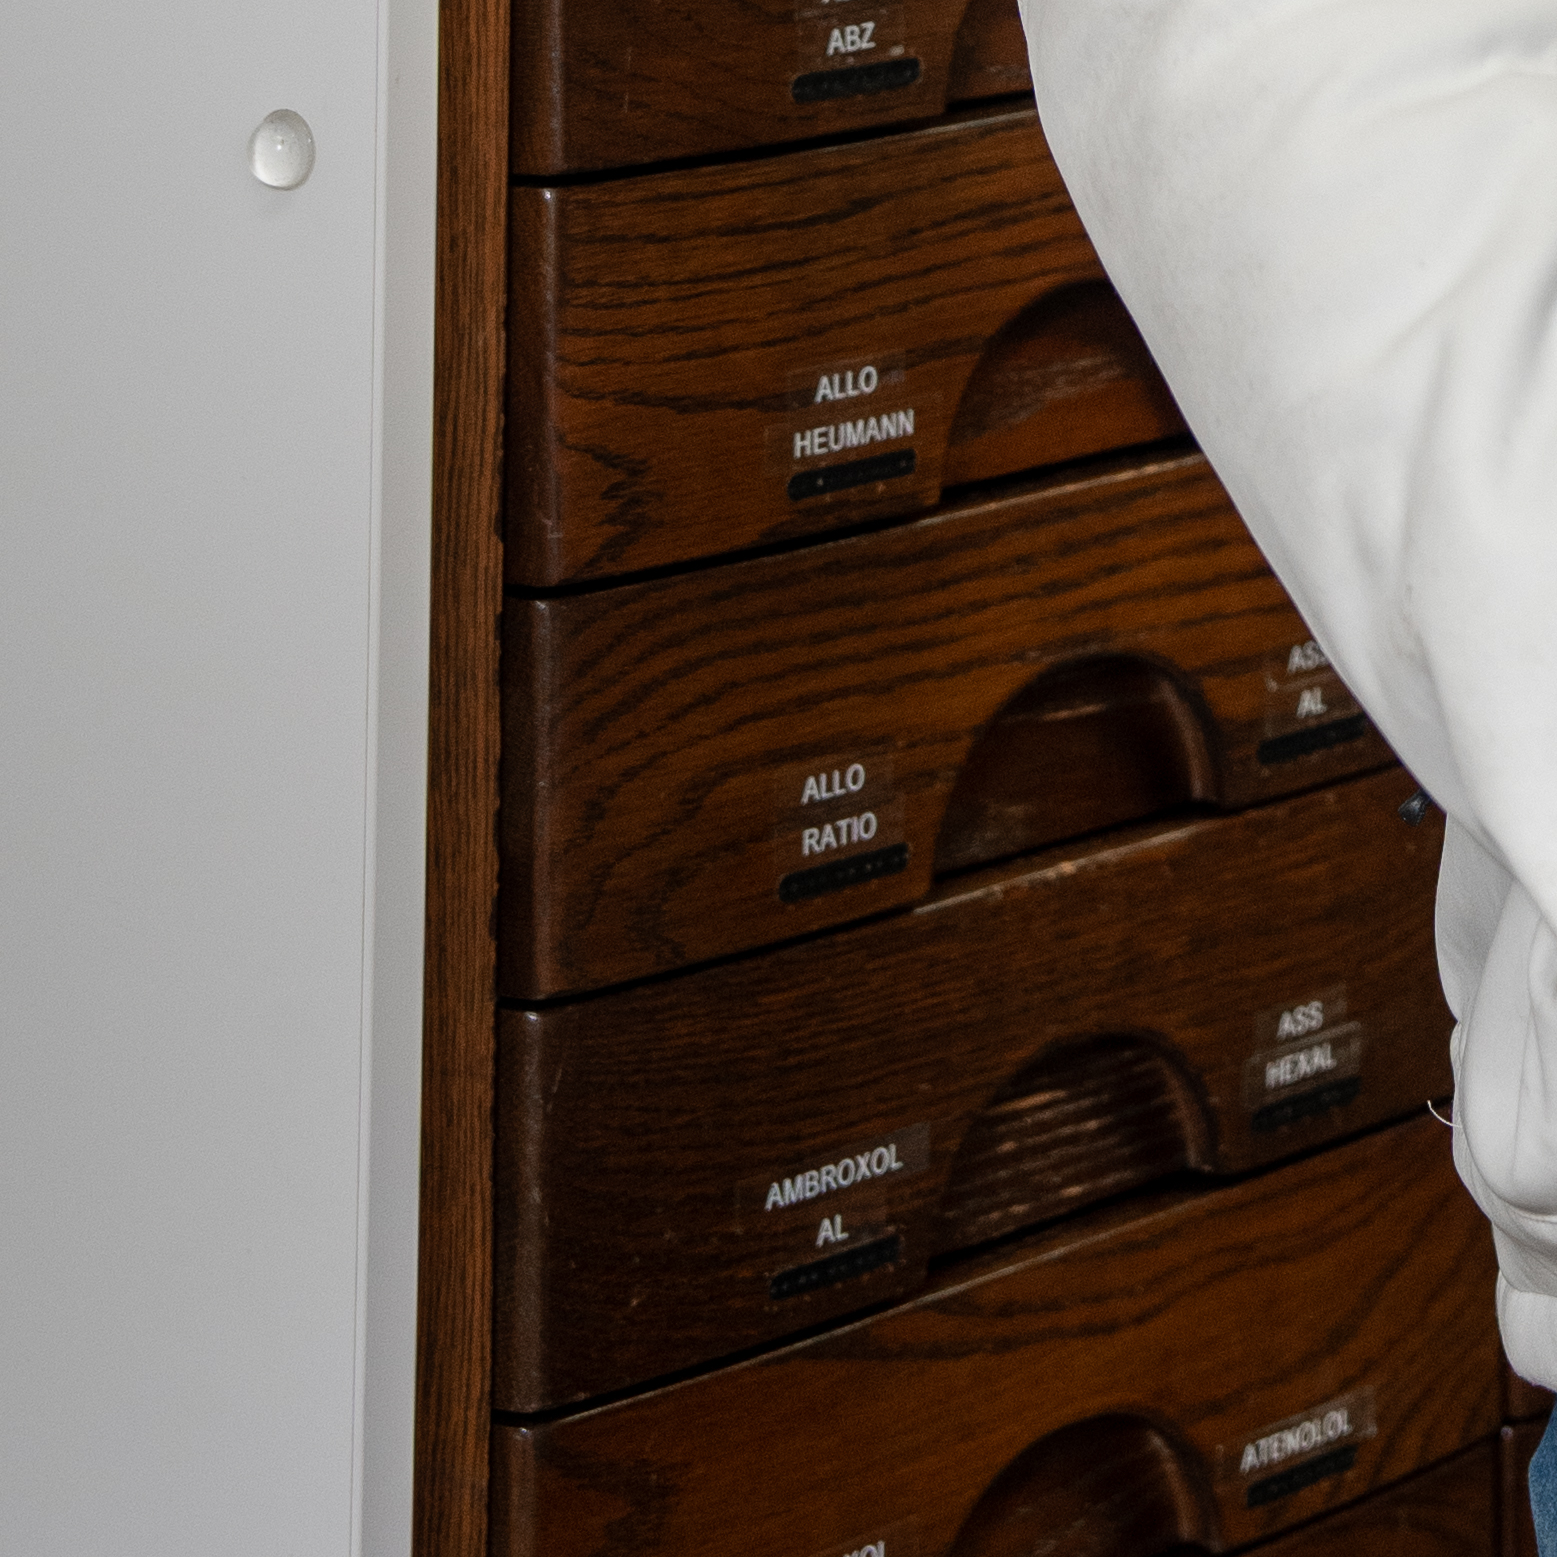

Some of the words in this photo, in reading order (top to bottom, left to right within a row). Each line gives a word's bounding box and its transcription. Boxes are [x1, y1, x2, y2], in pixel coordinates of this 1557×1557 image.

[827, 21, 876, 56] ABZ
[814, 365, 878, 404] ALLO
[793, 409, 915, 458] HEUMANN
[801, 763, 866, 804] ALLO
[802, 811, 878, 856] RATIO
[1277, 1000, 1324, 1037] ASS
[765, 1143, 904, 1211] AMBROXOL
[816, 1214, 849, 1247] AL
[1240, 1406, 1352, 1474] ATENOLOL
